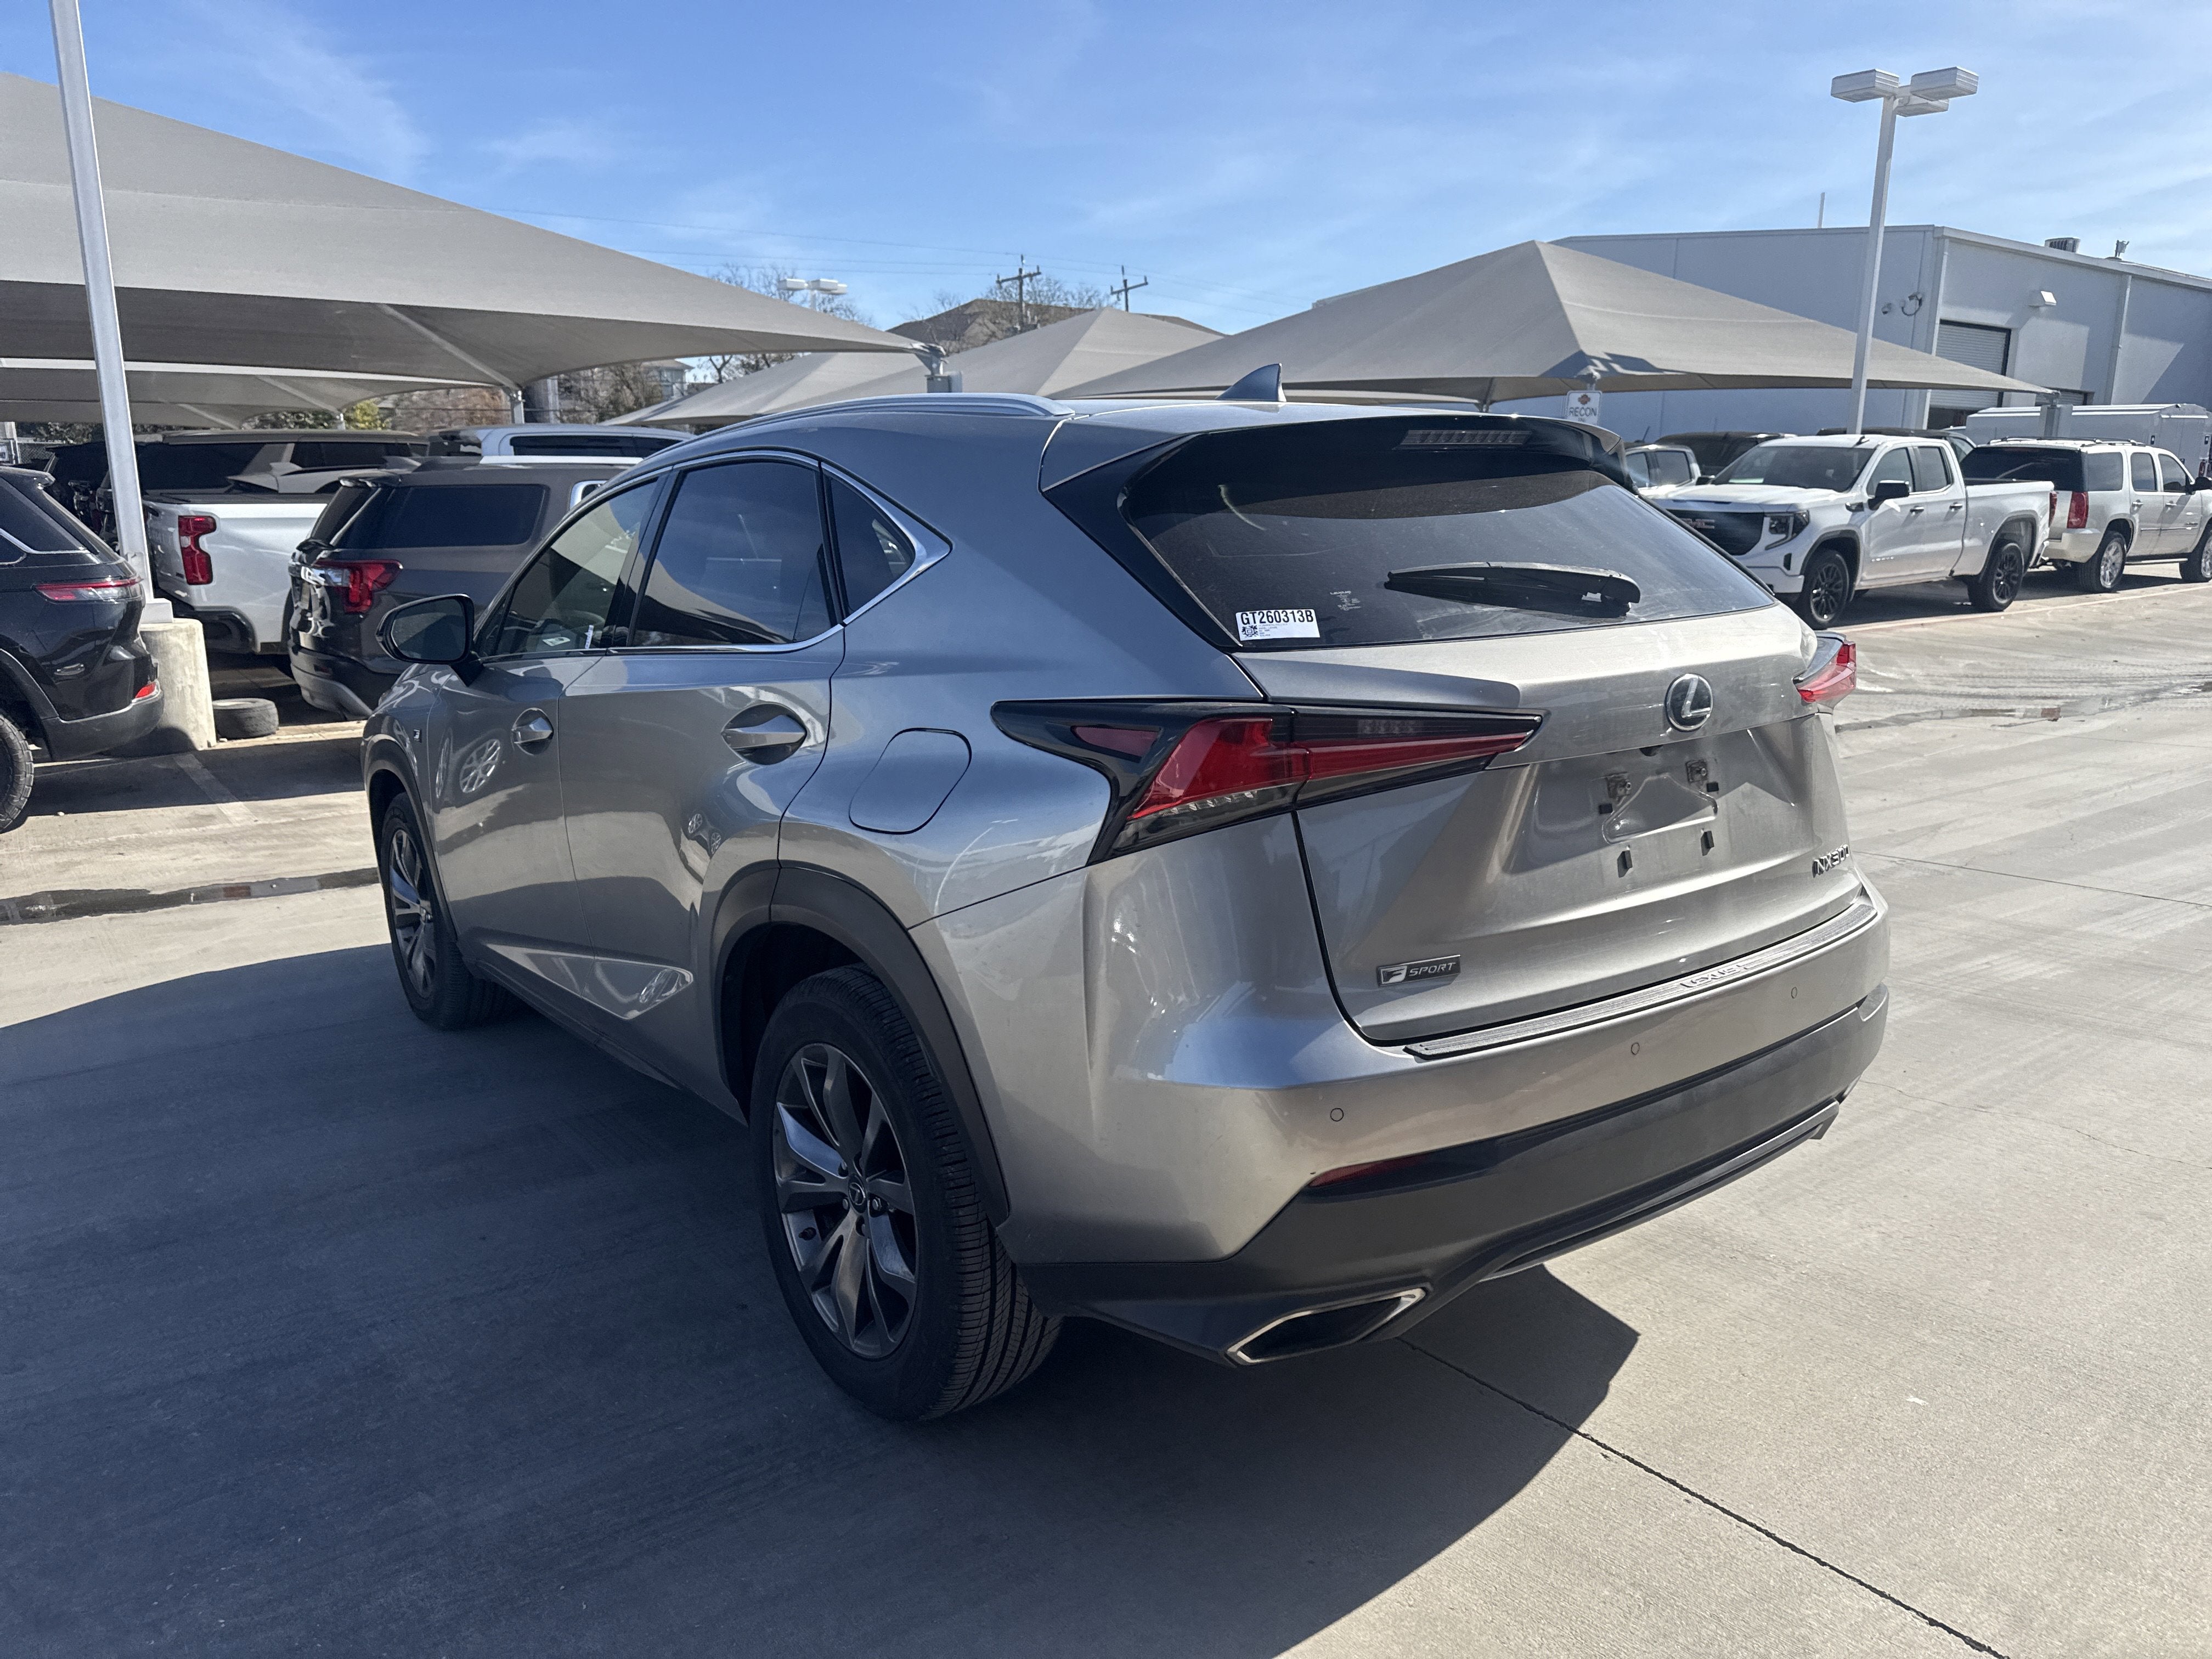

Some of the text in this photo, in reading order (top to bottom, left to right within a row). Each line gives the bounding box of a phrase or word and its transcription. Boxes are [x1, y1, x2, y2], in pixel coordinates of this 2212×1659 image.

[1568, 407, 1598, 417] RECON
[1240, 610, 1314, 625] GT260313B
[1408, 962, 1457, 977] SPORT
[1679, 967, 1741, 988] LEXUS
